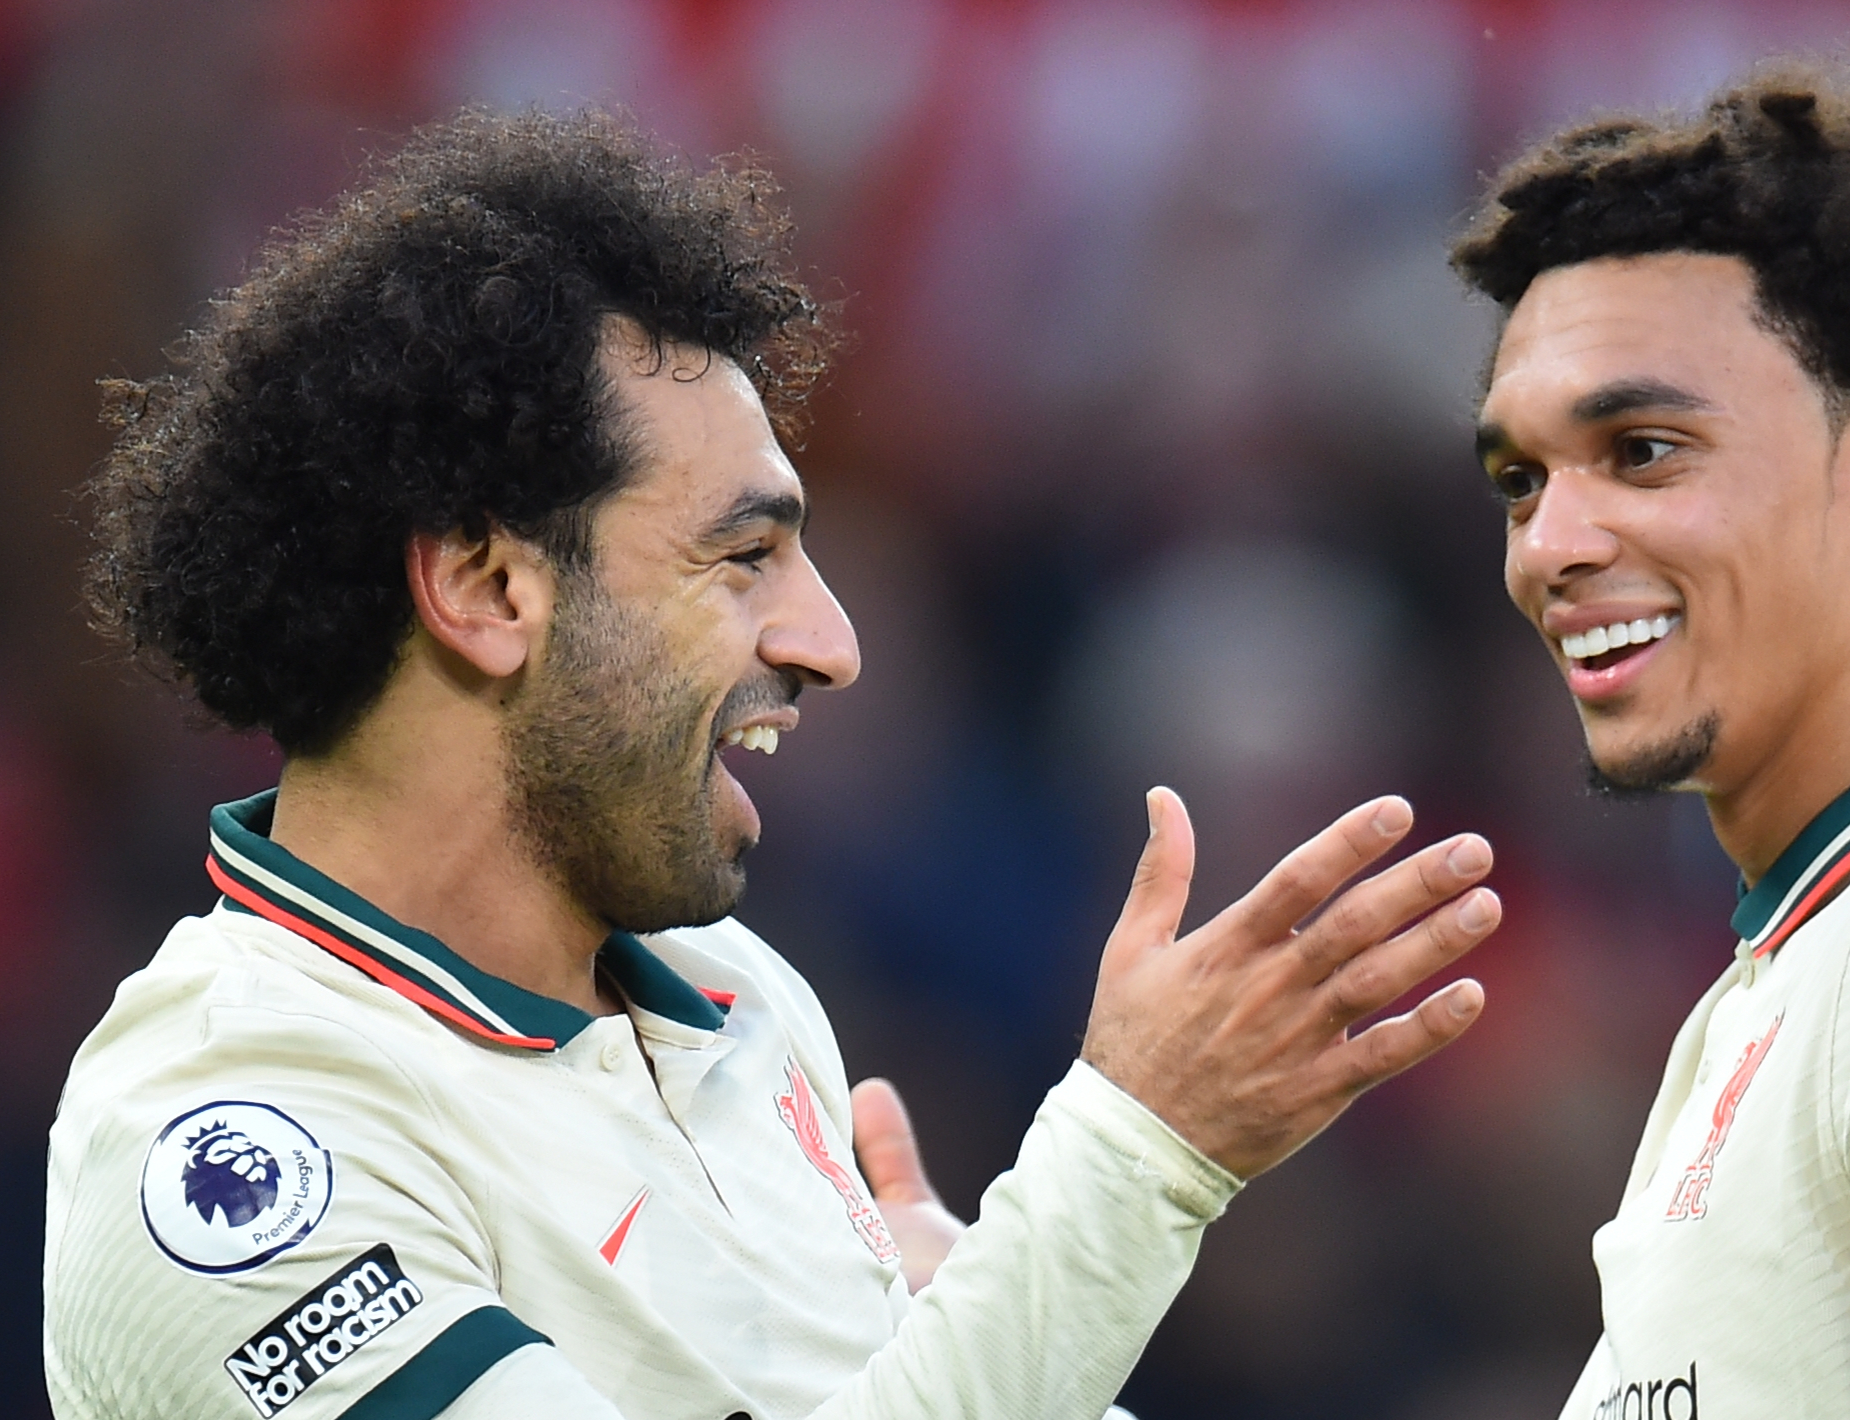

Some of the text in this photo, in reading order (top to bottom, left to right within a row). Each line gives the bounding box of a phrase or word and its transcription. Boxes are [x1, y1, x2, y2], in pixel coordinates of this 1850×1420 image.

[252, 1149, 314, 1246] Premier League
[226, 1261, 390, 1392] No room
[249, 1279, 423, 1418] for racism
